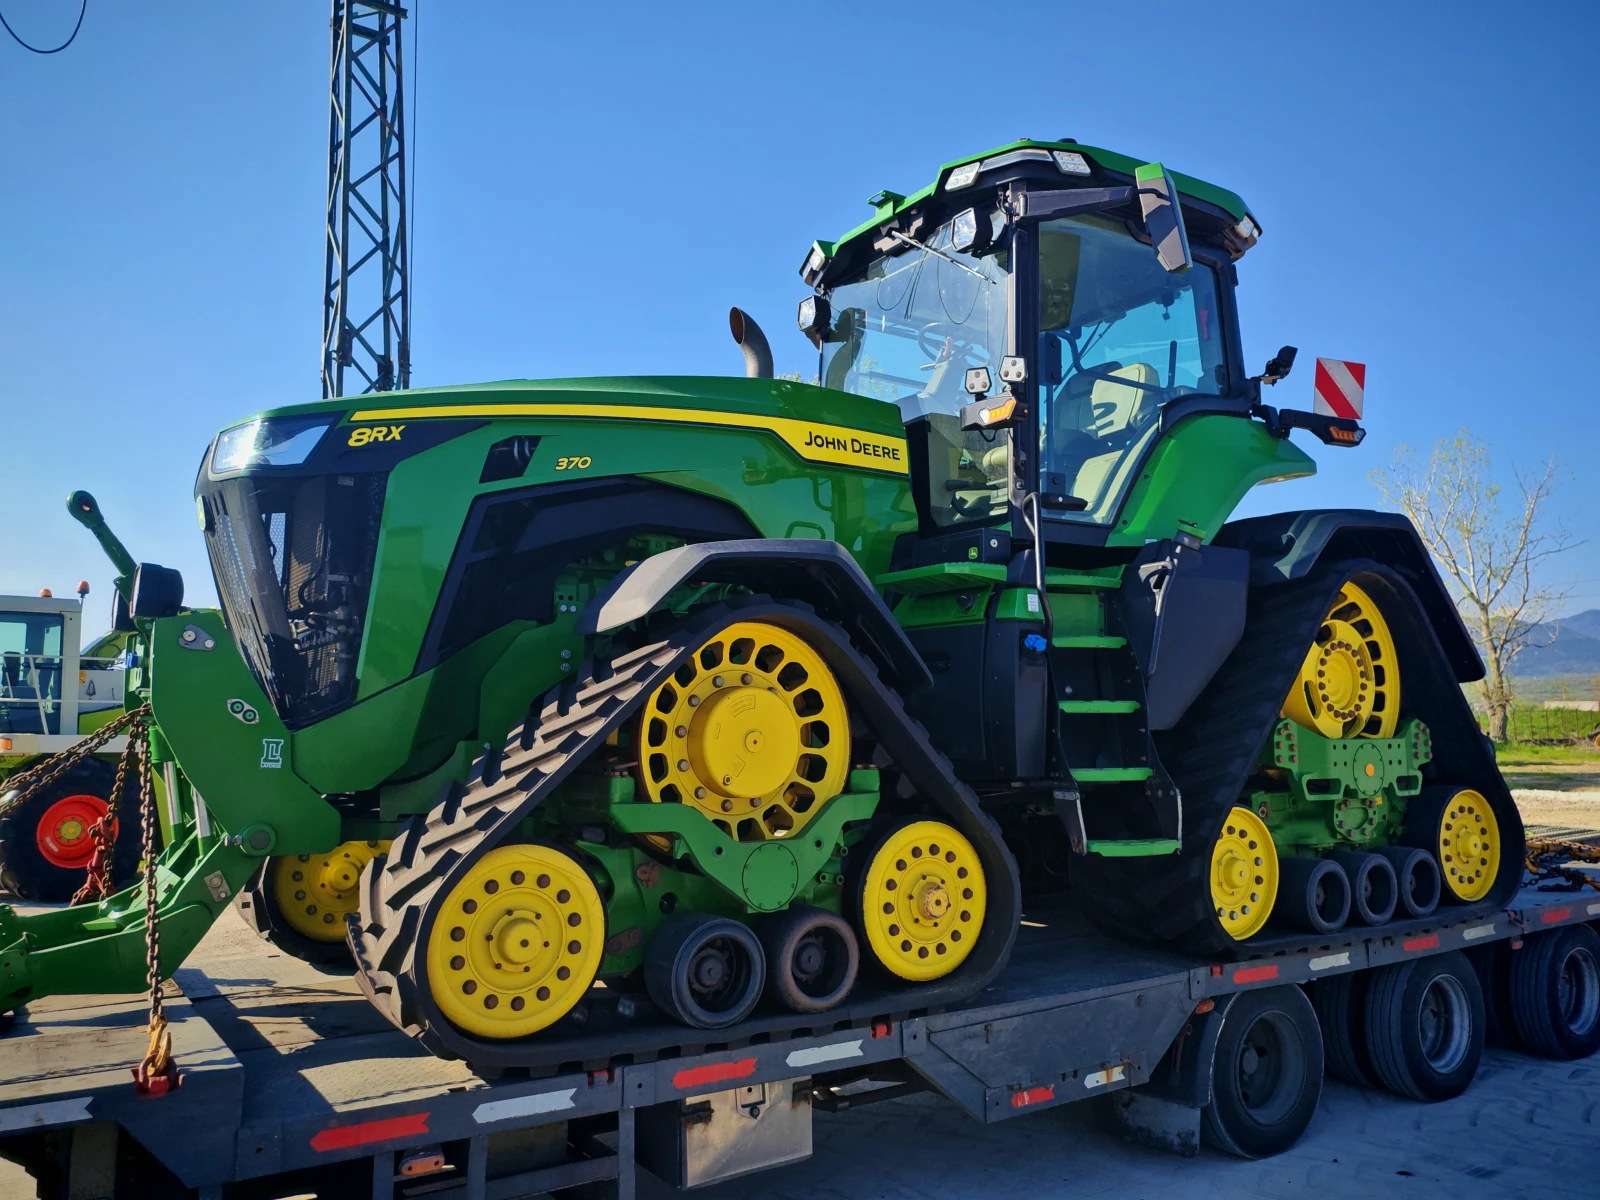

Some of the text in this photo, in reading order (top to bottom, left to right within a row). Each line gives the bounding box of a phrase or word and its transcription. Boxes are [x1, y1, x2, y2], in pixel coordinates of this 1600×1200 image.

[347, 425, 406, 447] 8RX
[804, 431, 901, 461] JOHN DEERE
[555, 456, 592, 471] 370
